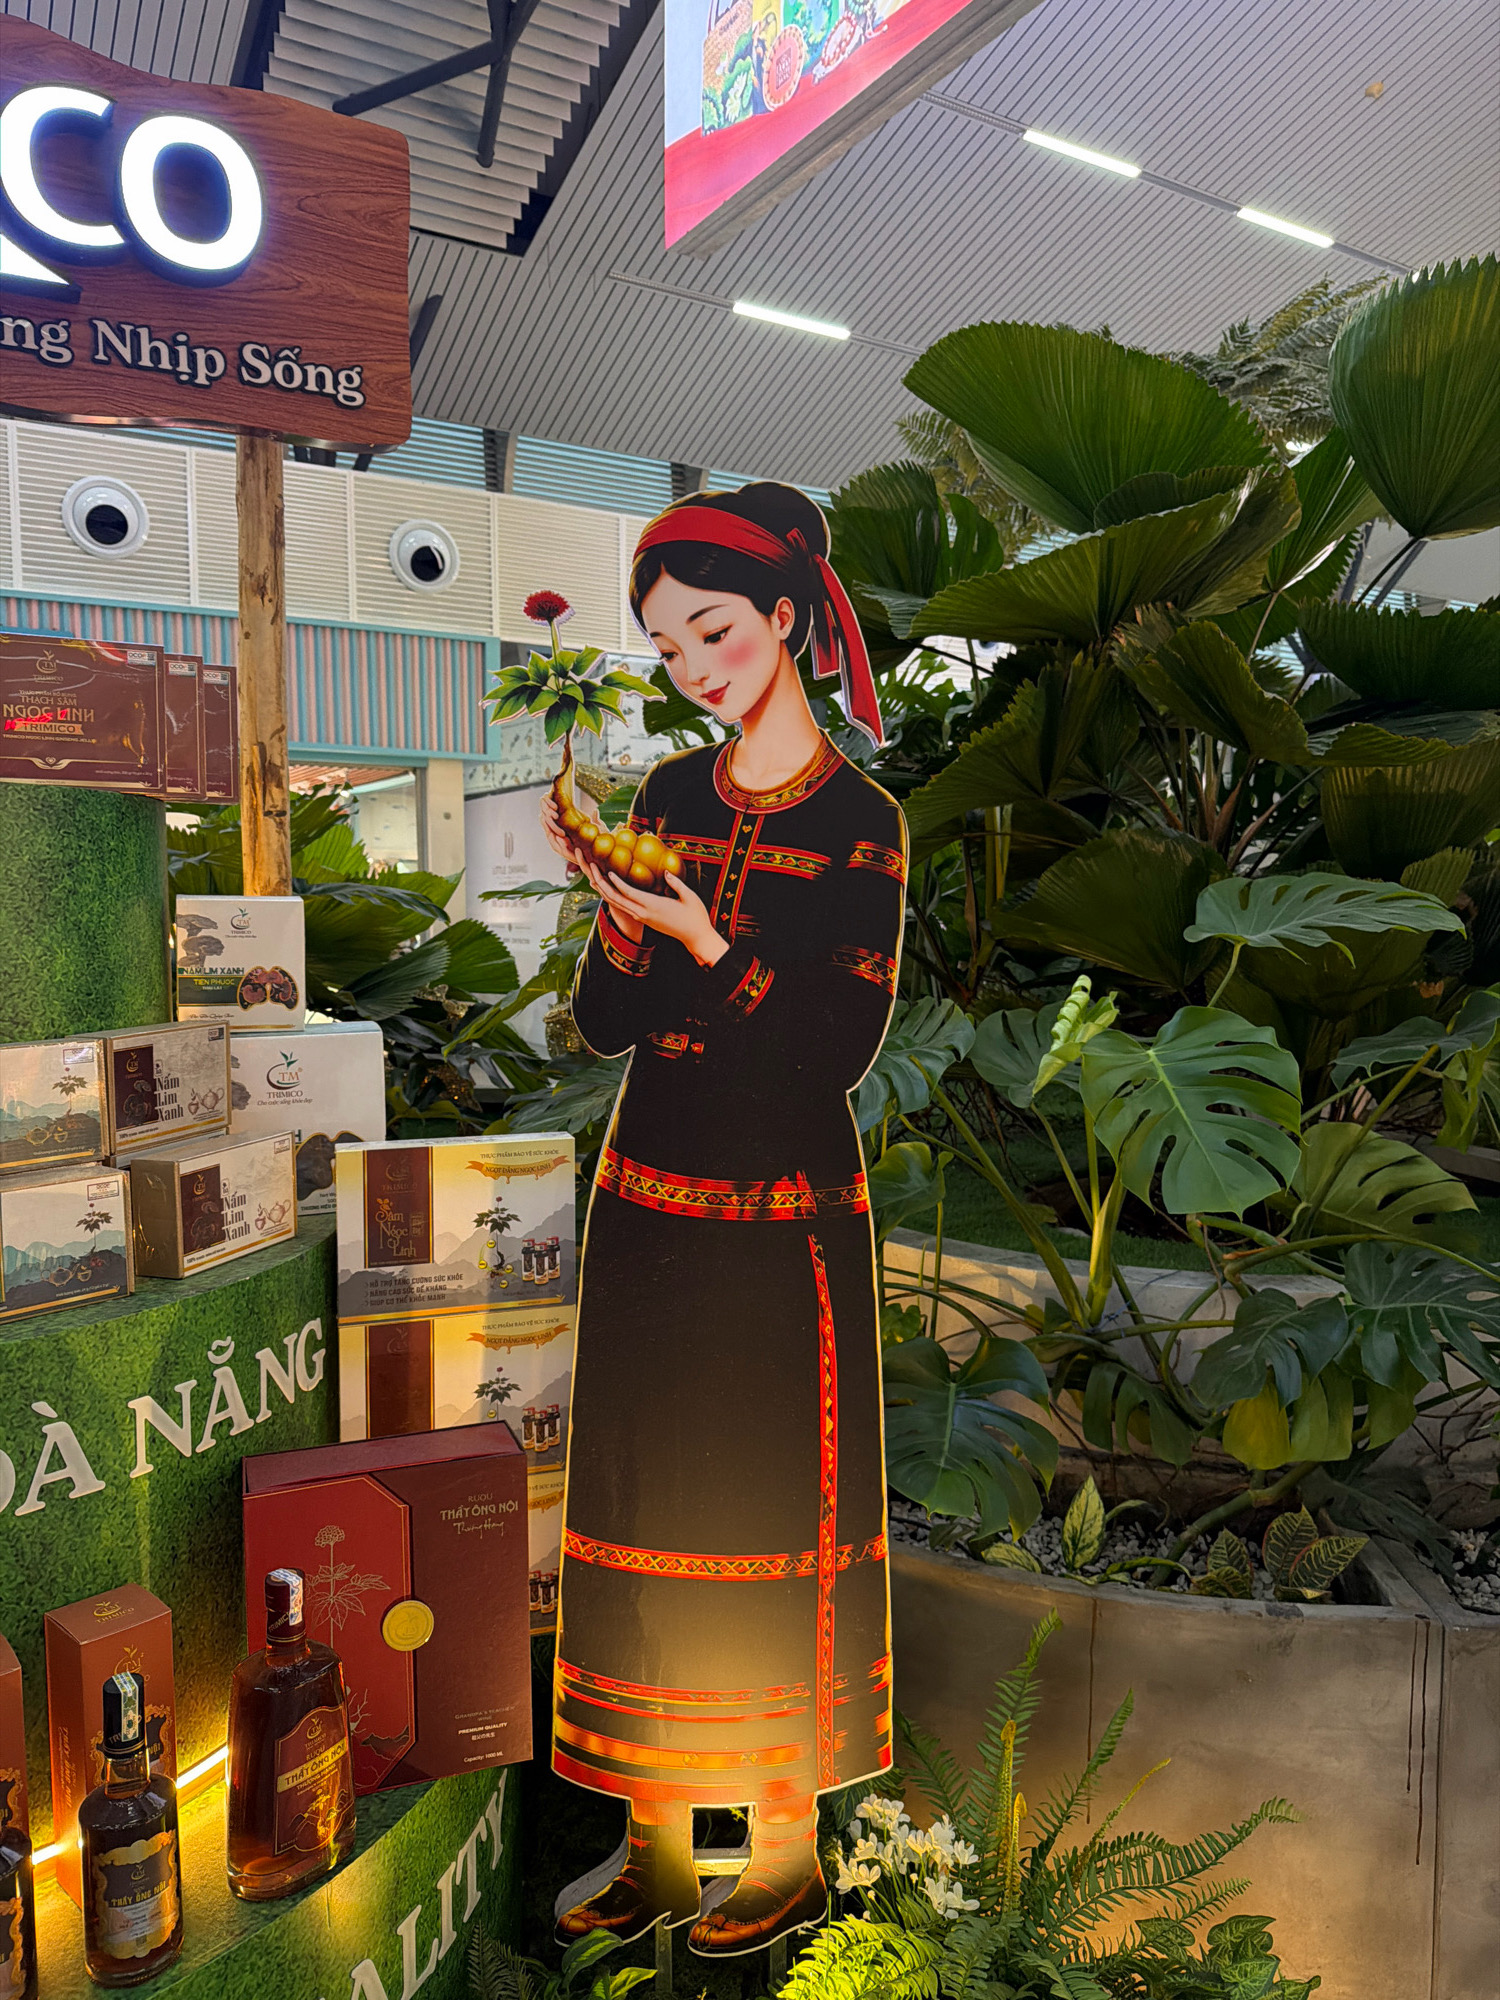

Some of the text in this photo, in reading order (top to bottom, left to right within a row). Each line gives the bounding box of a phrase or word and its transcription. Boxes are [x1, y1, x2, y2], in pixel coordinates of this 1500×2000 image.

[91, 318, 225, 386] Nhịp
[240, 343, 366, 407] Sống
[57, 707, 94, 722] LINH
[24, 722, 76, 733] TRIMICO
[154, 1073, 180, 1091] Nấm
[279, 1071, 300, 1082] TM
[155, 1091, 178, 1107] Lim
[267, 1090, 303, 1098] TRIMICO
[155, 1104, 183, 1122] Xanh
[221, 1191, 247, 1211] Nấm
[221, 1210, 244, 1227] Lim
[222, 1222, 251, 1241] Xanh
[393, 1240, 417, 1257] Linh
[128, 1318, 326, 1479] NẴNG
[471, 1504, 496, 1516] ÔNG
[499, 1500, 518, 1513] NỘI
[96, 1607, 135, 1623] TRIMICO
[458, 1722, 508, 1735] PREMIUM QUALITY
